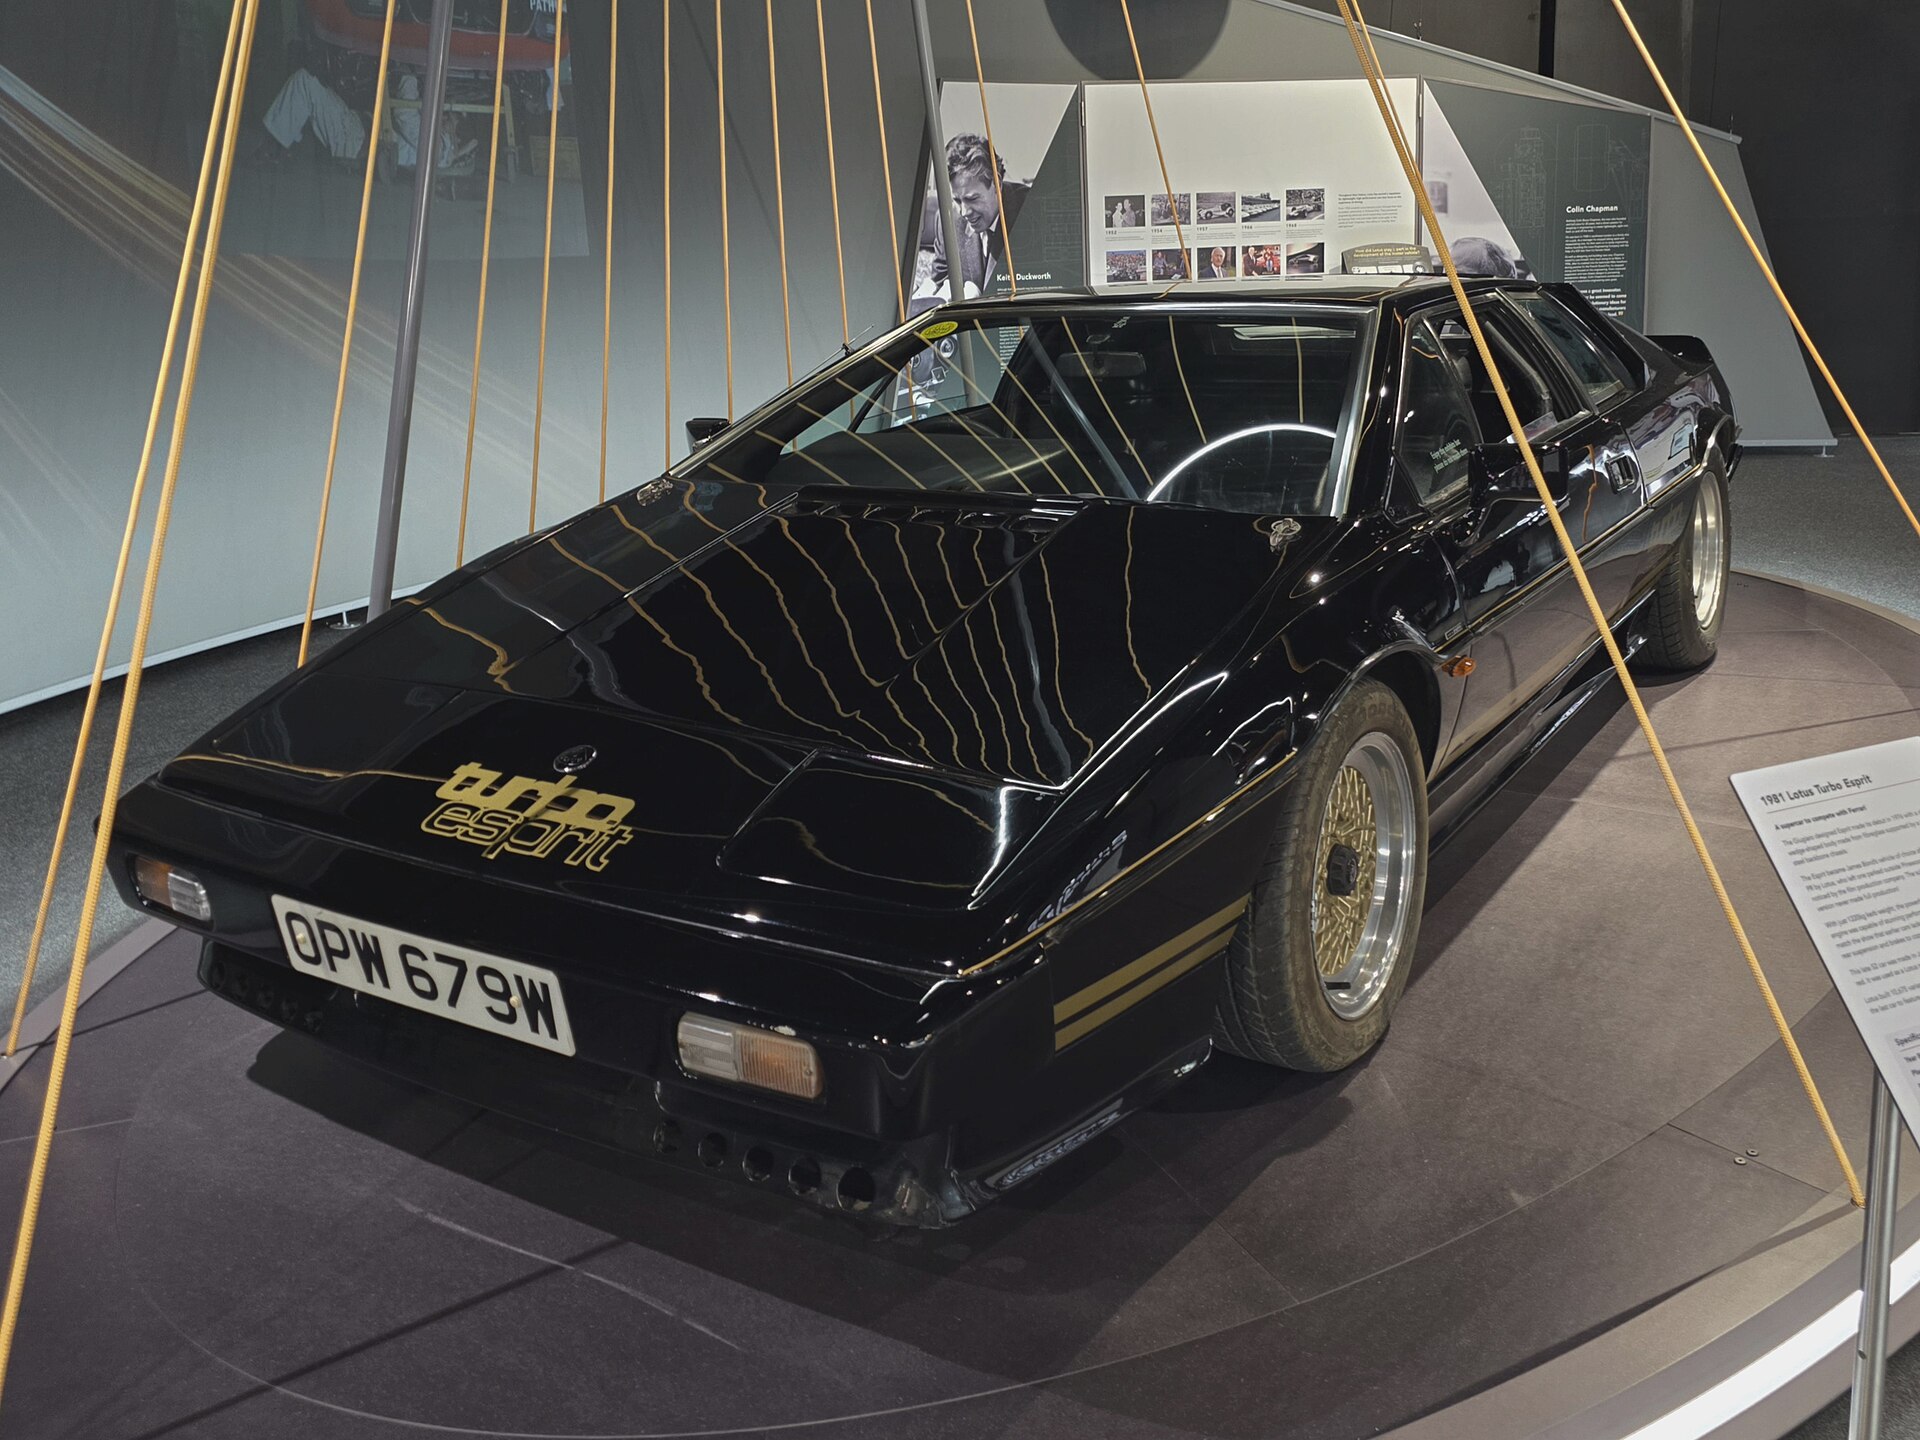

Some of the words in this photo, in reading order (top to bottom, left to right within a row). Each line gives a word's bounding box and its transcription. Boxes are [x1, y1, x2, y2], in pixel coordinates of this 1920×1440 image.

[1566, 205, 1584, 213] Colin
[1586, 204, 1618, 214] Chapman
[1016, 272, 1051, 280] Duckworth
[436, 762, 635, 831] turbo
[1760, 794, 1786, 806] 1981
[1786, 787, 1814, 802] Lotus
[1814, 781, 1843, 796] Turbo
[1842, 774, 1873, 790] Esprit
[421, 800, 633, 872] esprit
[285, 911, 391, 990] OPW
[398, 944, 559, 1041] 679W
